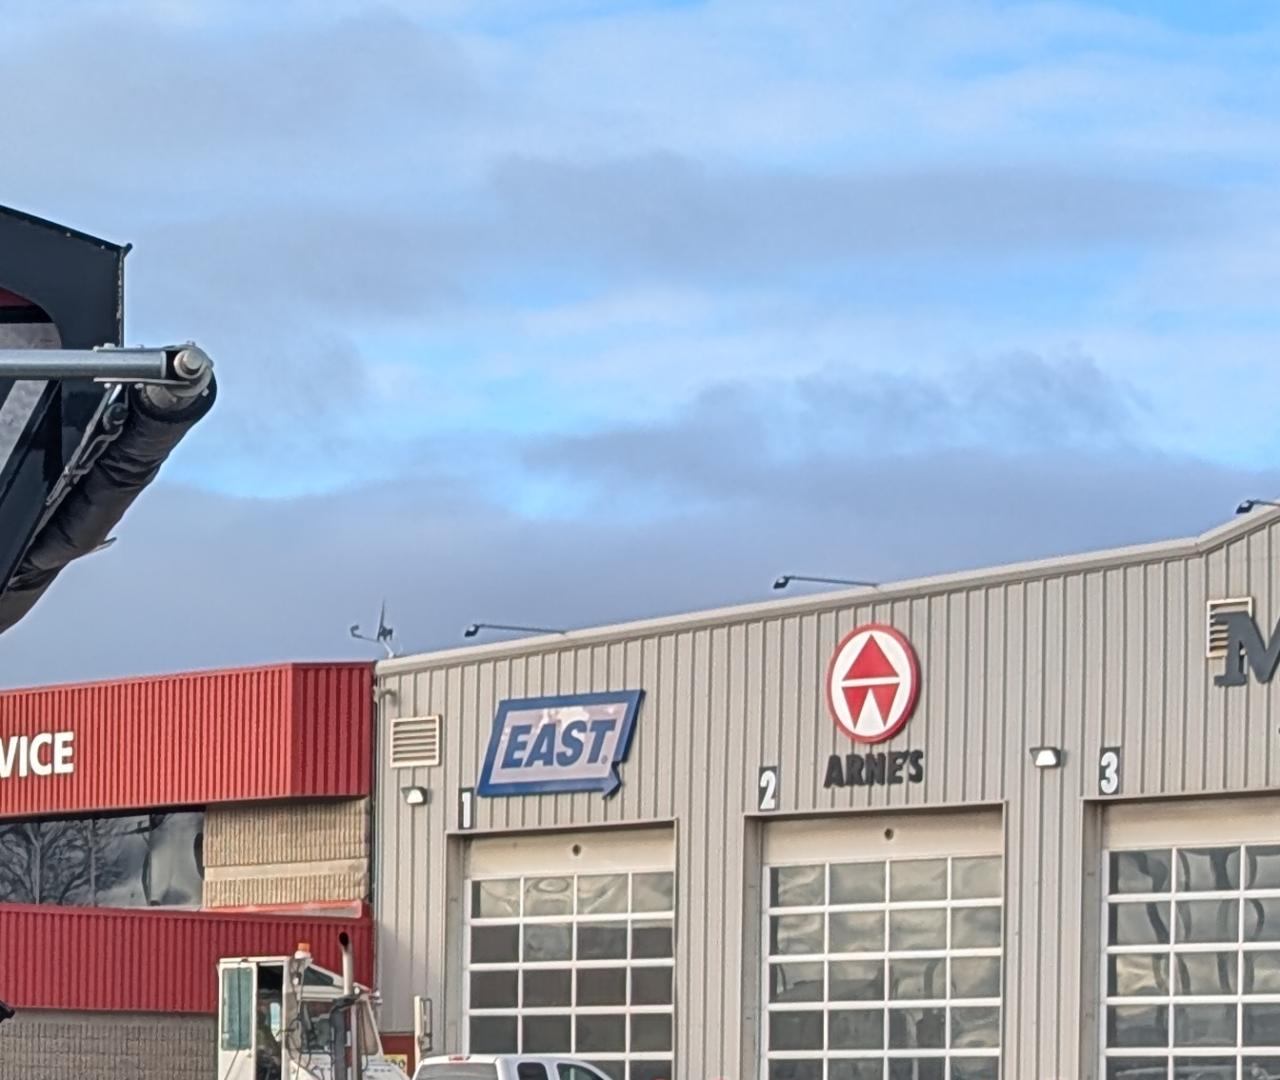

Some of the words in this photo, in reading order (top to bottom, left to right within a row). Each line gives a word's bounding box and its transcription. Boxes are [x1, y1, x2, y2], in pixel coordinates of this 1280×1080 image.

[501, 719, 617, 769] EAST
[823, 749, 924, 789] ARNE'S
[1100, 751, 1119, 794] 3
[461, 791, 472, 829] 1
[760, 770, 777, 810] 2
